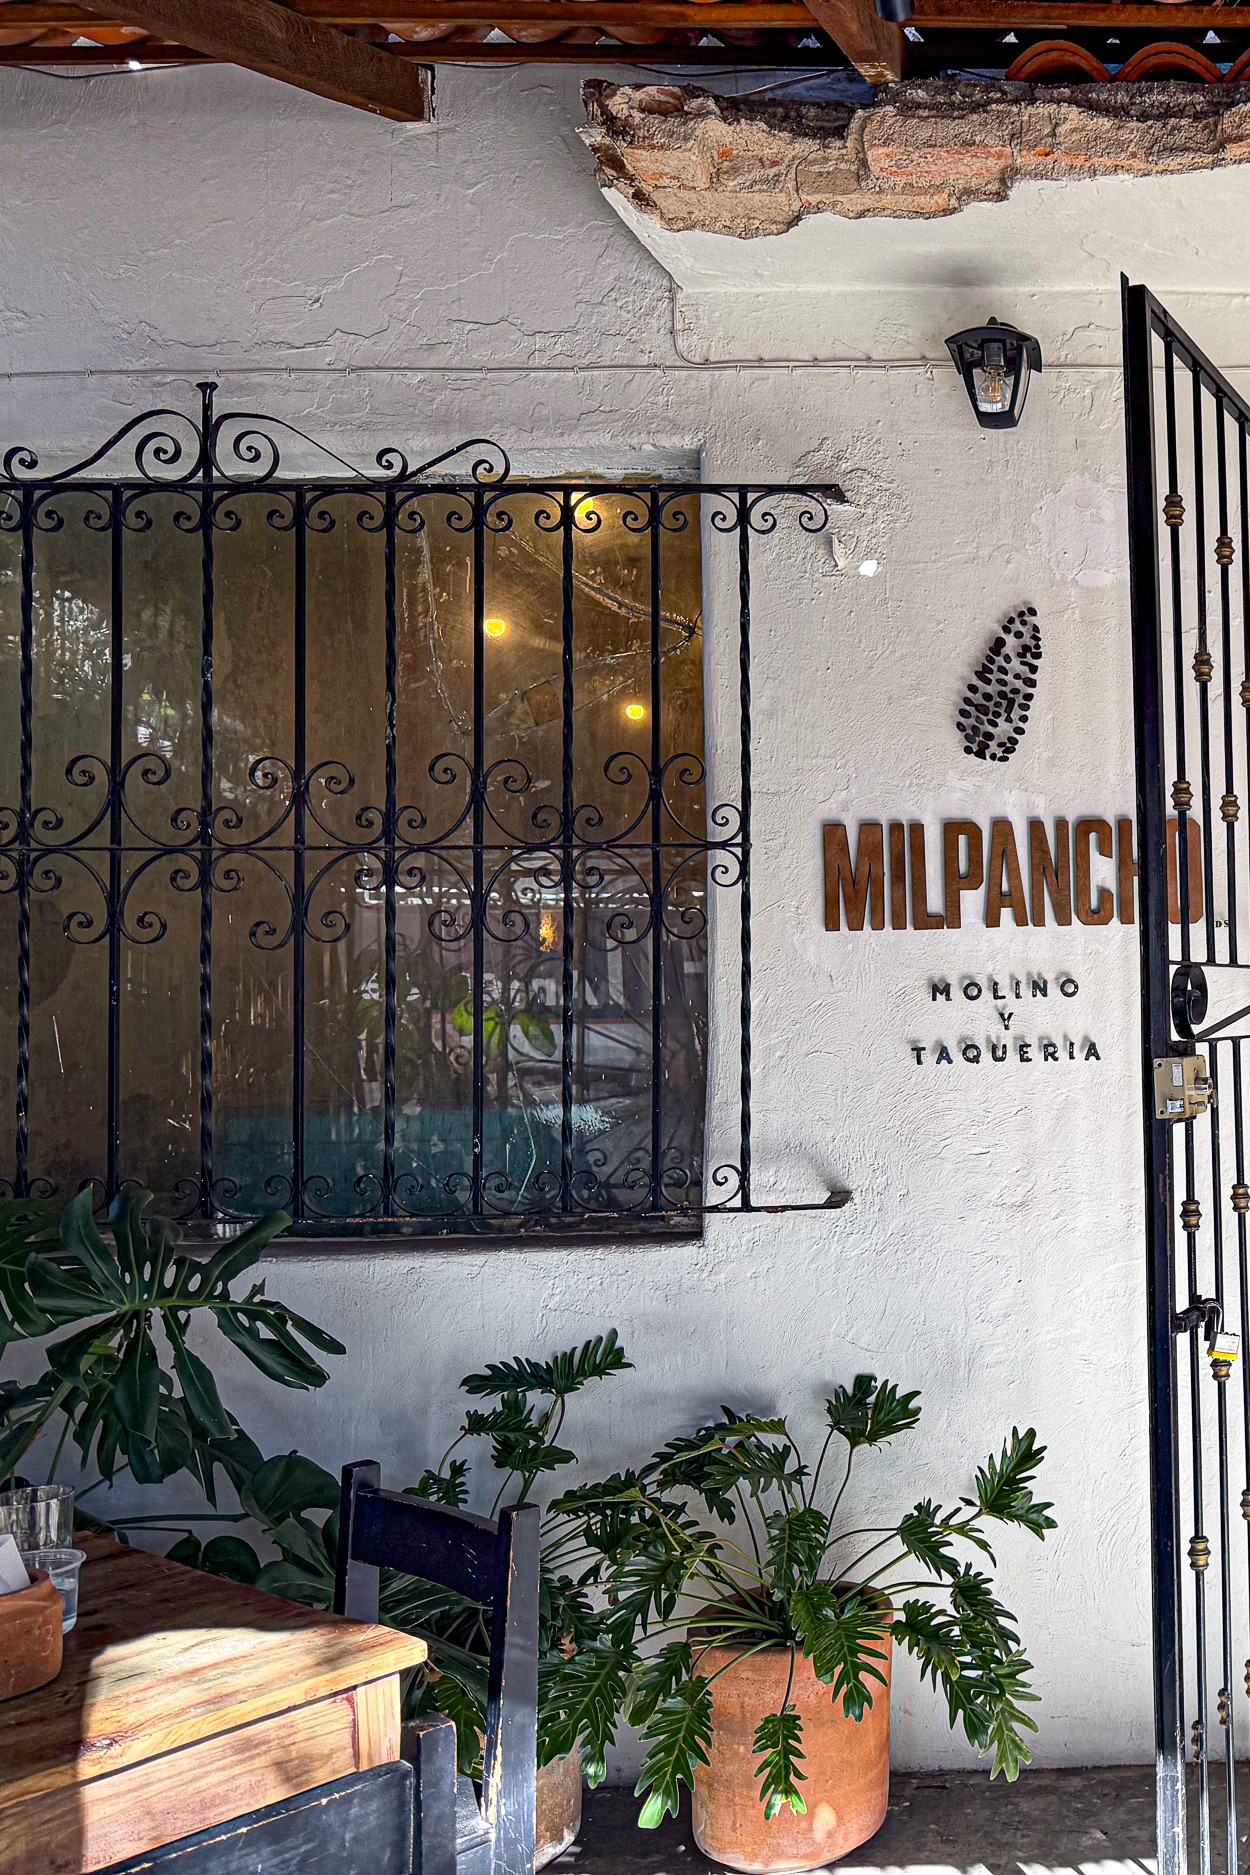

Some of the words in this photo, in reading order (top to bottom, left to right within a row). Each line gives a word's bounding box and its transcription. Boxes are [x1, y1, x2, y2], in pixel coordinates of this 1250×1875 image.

[931, 978, 1079, 1001] MOLINO
[998, 1012, 1014, 1030] Y
[911, 1041, 1101, 1065] TAQUERIA
